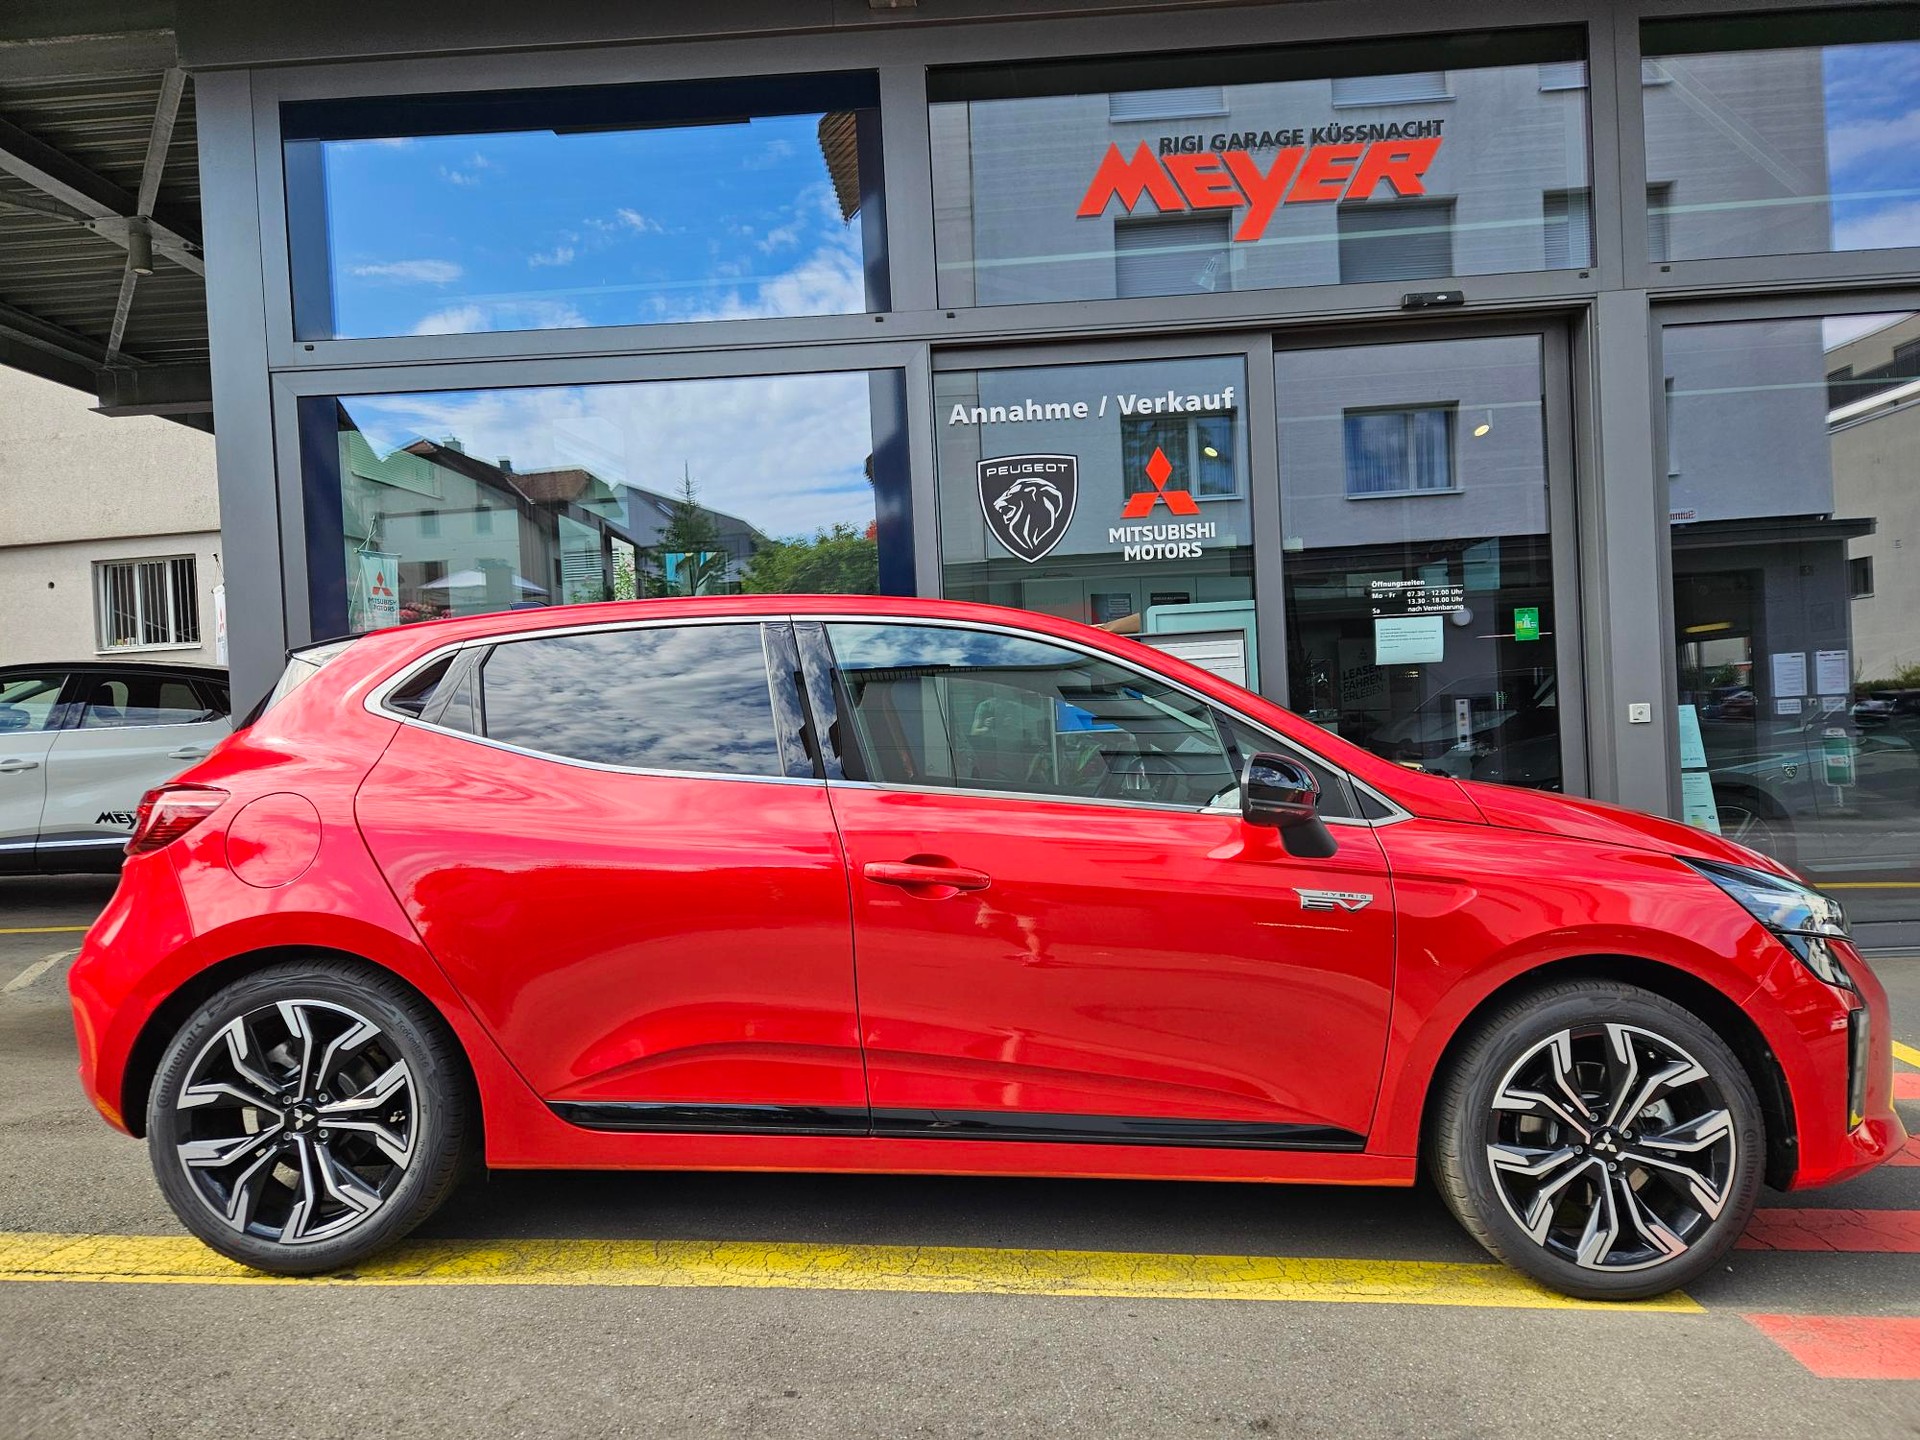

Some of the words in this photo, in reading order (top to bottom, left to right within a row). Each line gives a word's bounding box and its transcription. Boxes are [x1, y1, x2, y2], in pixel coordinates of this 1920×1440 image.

[1158, 134, 1204, 154] RIGI
[1210, 129, 1304, 150] GARAGE
[1311, 119, 1445, 144] KÜSSNACHT
[1075, 138, 1444, 242] MEYER
[949, 399, 1088, 425] Annahme
[1117, 387, 1235, 415] Verkauf
[986, 463, 1069, 477] PEUGEOT
[1108, 522, 1216, 544] MITSUBISHI
[1124, 542, 1203, 562] MOTORS
[1371, 579, 1425, 588] Öffnungszeiten
[1422, 603, 1464, 612] Vereinbarung
[95, 811, 137, 830] MEY
[1321, 891, 1367, 900] HYBRID
